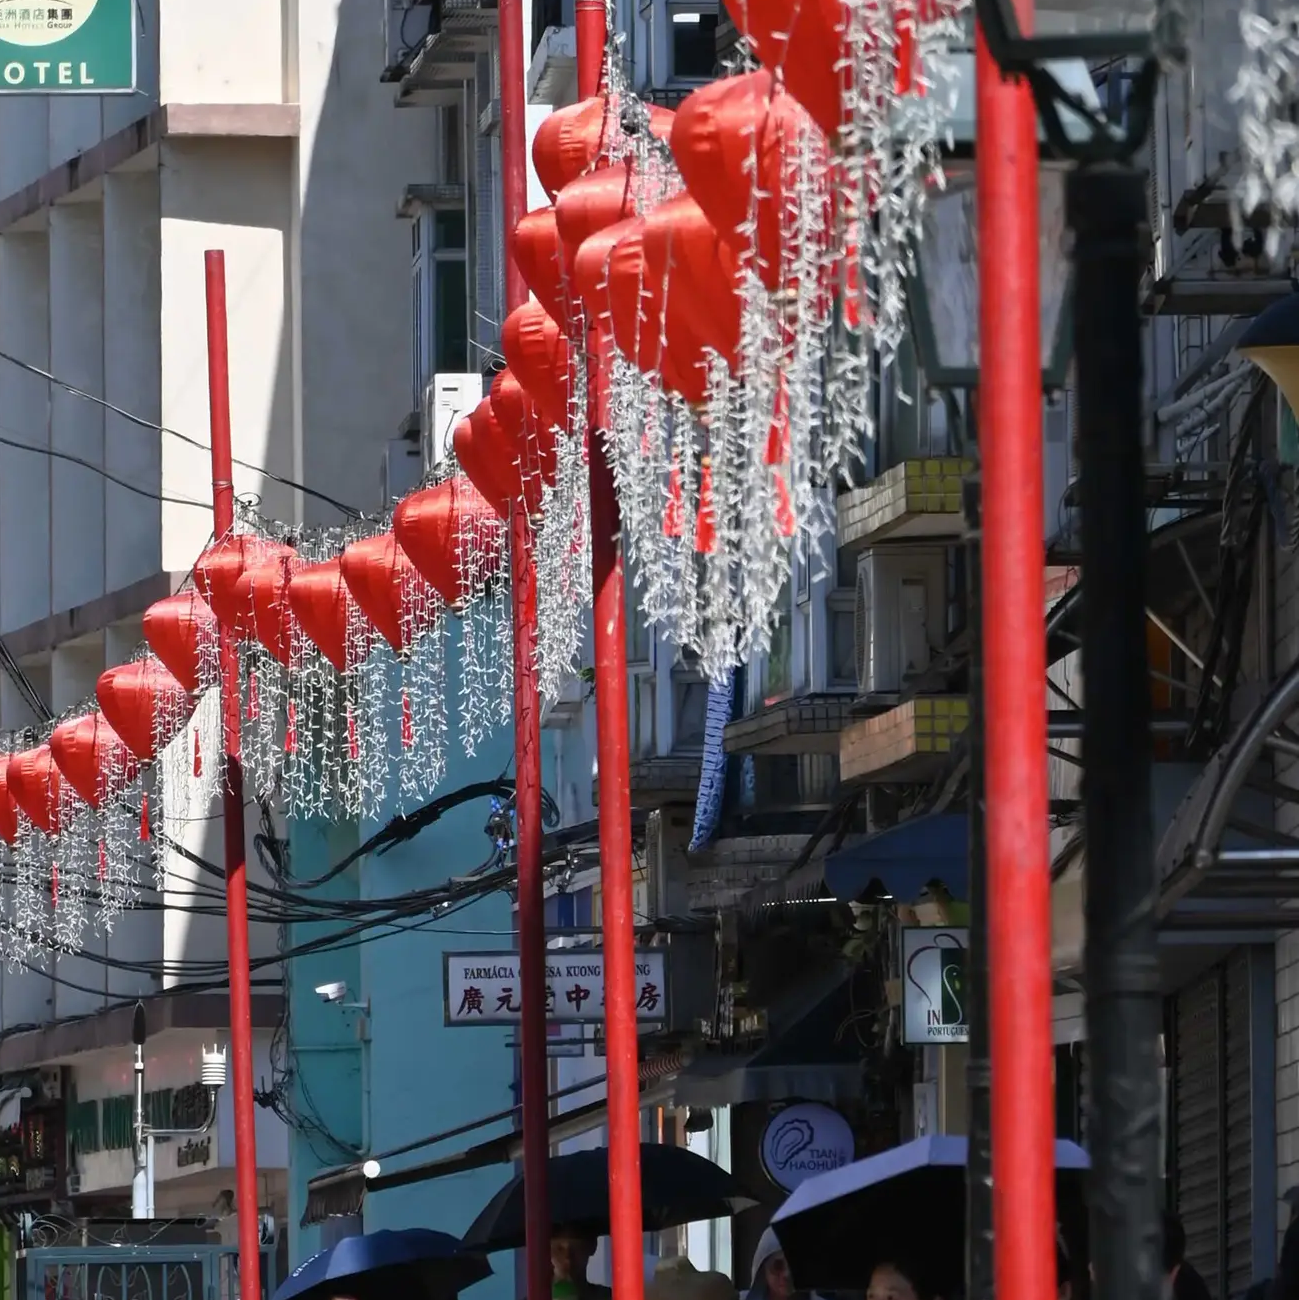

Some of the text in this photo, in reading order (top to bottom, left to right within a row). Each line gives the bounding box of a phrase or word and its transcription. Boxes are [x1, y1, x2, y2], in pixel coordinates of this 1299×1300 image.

[463, 965, 515, 980] FARMÁCIA
[565, 965, 601, 978] KUONG
[809, 1148, 837, 1159] TIAN
[789, 1159, 837, 1171] HAOHUI
